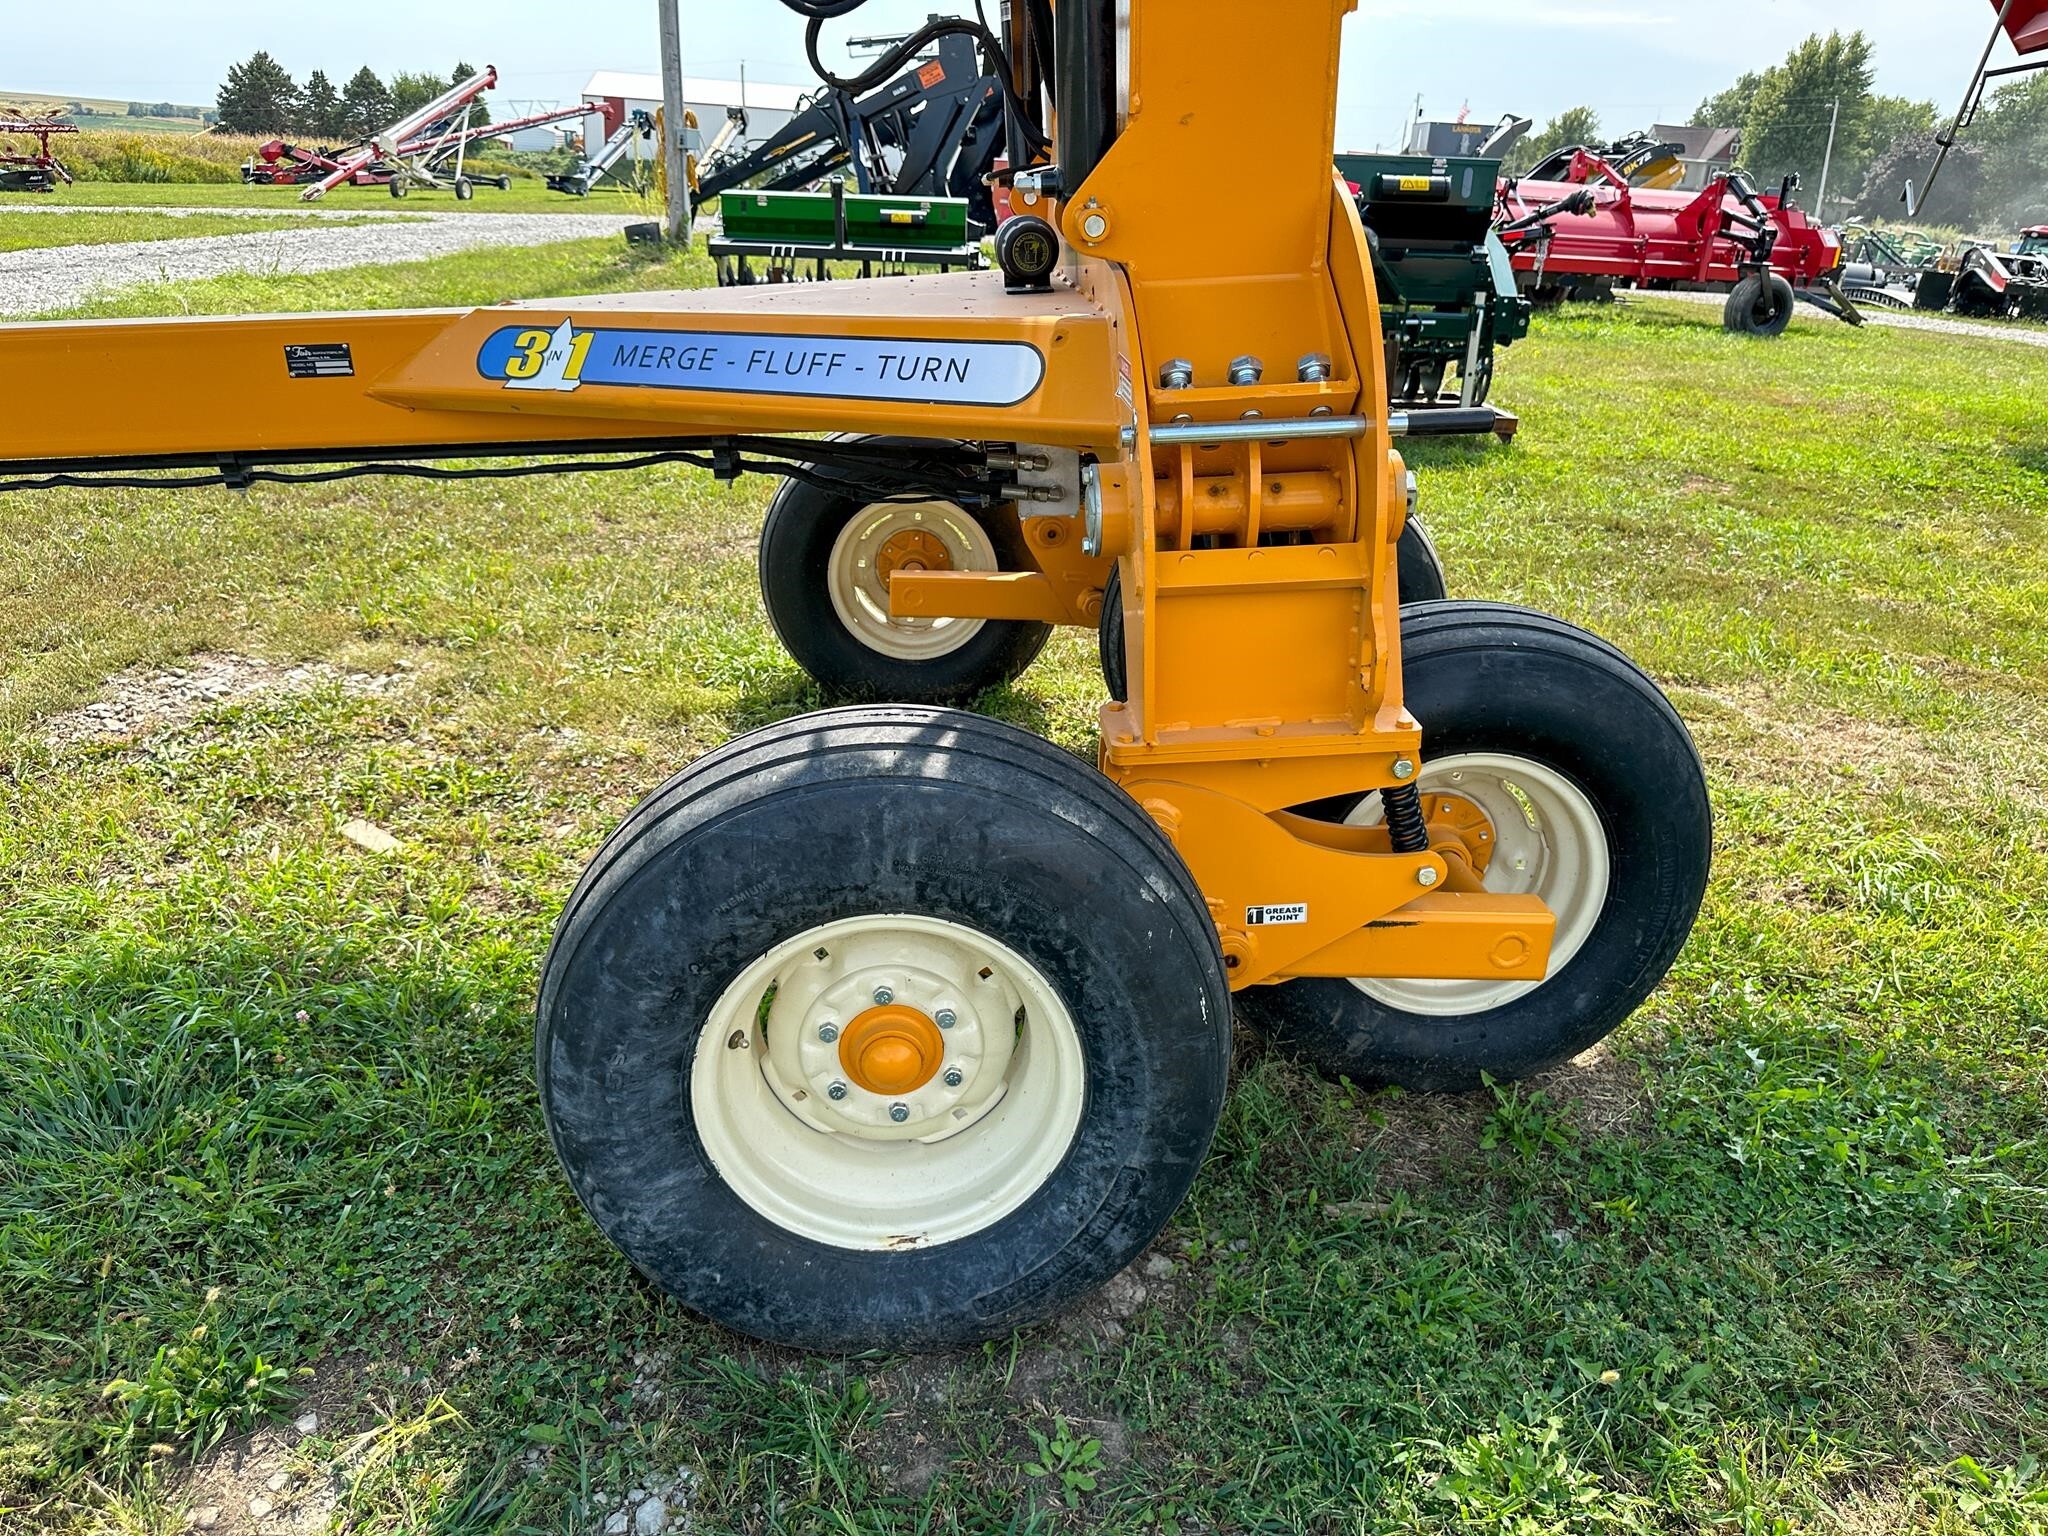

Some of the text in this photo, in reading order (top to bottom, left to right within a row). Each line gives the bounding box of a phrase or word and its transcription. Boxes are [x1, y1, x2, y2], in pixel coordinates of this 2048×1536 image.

[504, 330, 597, 382] 3 IN 1
[612, 343, 719, 371] MERGE
[746, 349, 846, 378] FLUFF
[878, 355, 971, 383] TURN
[1265, 906, 1304, 915] GREASE
[1269, 914, 1300, 922] POINT
